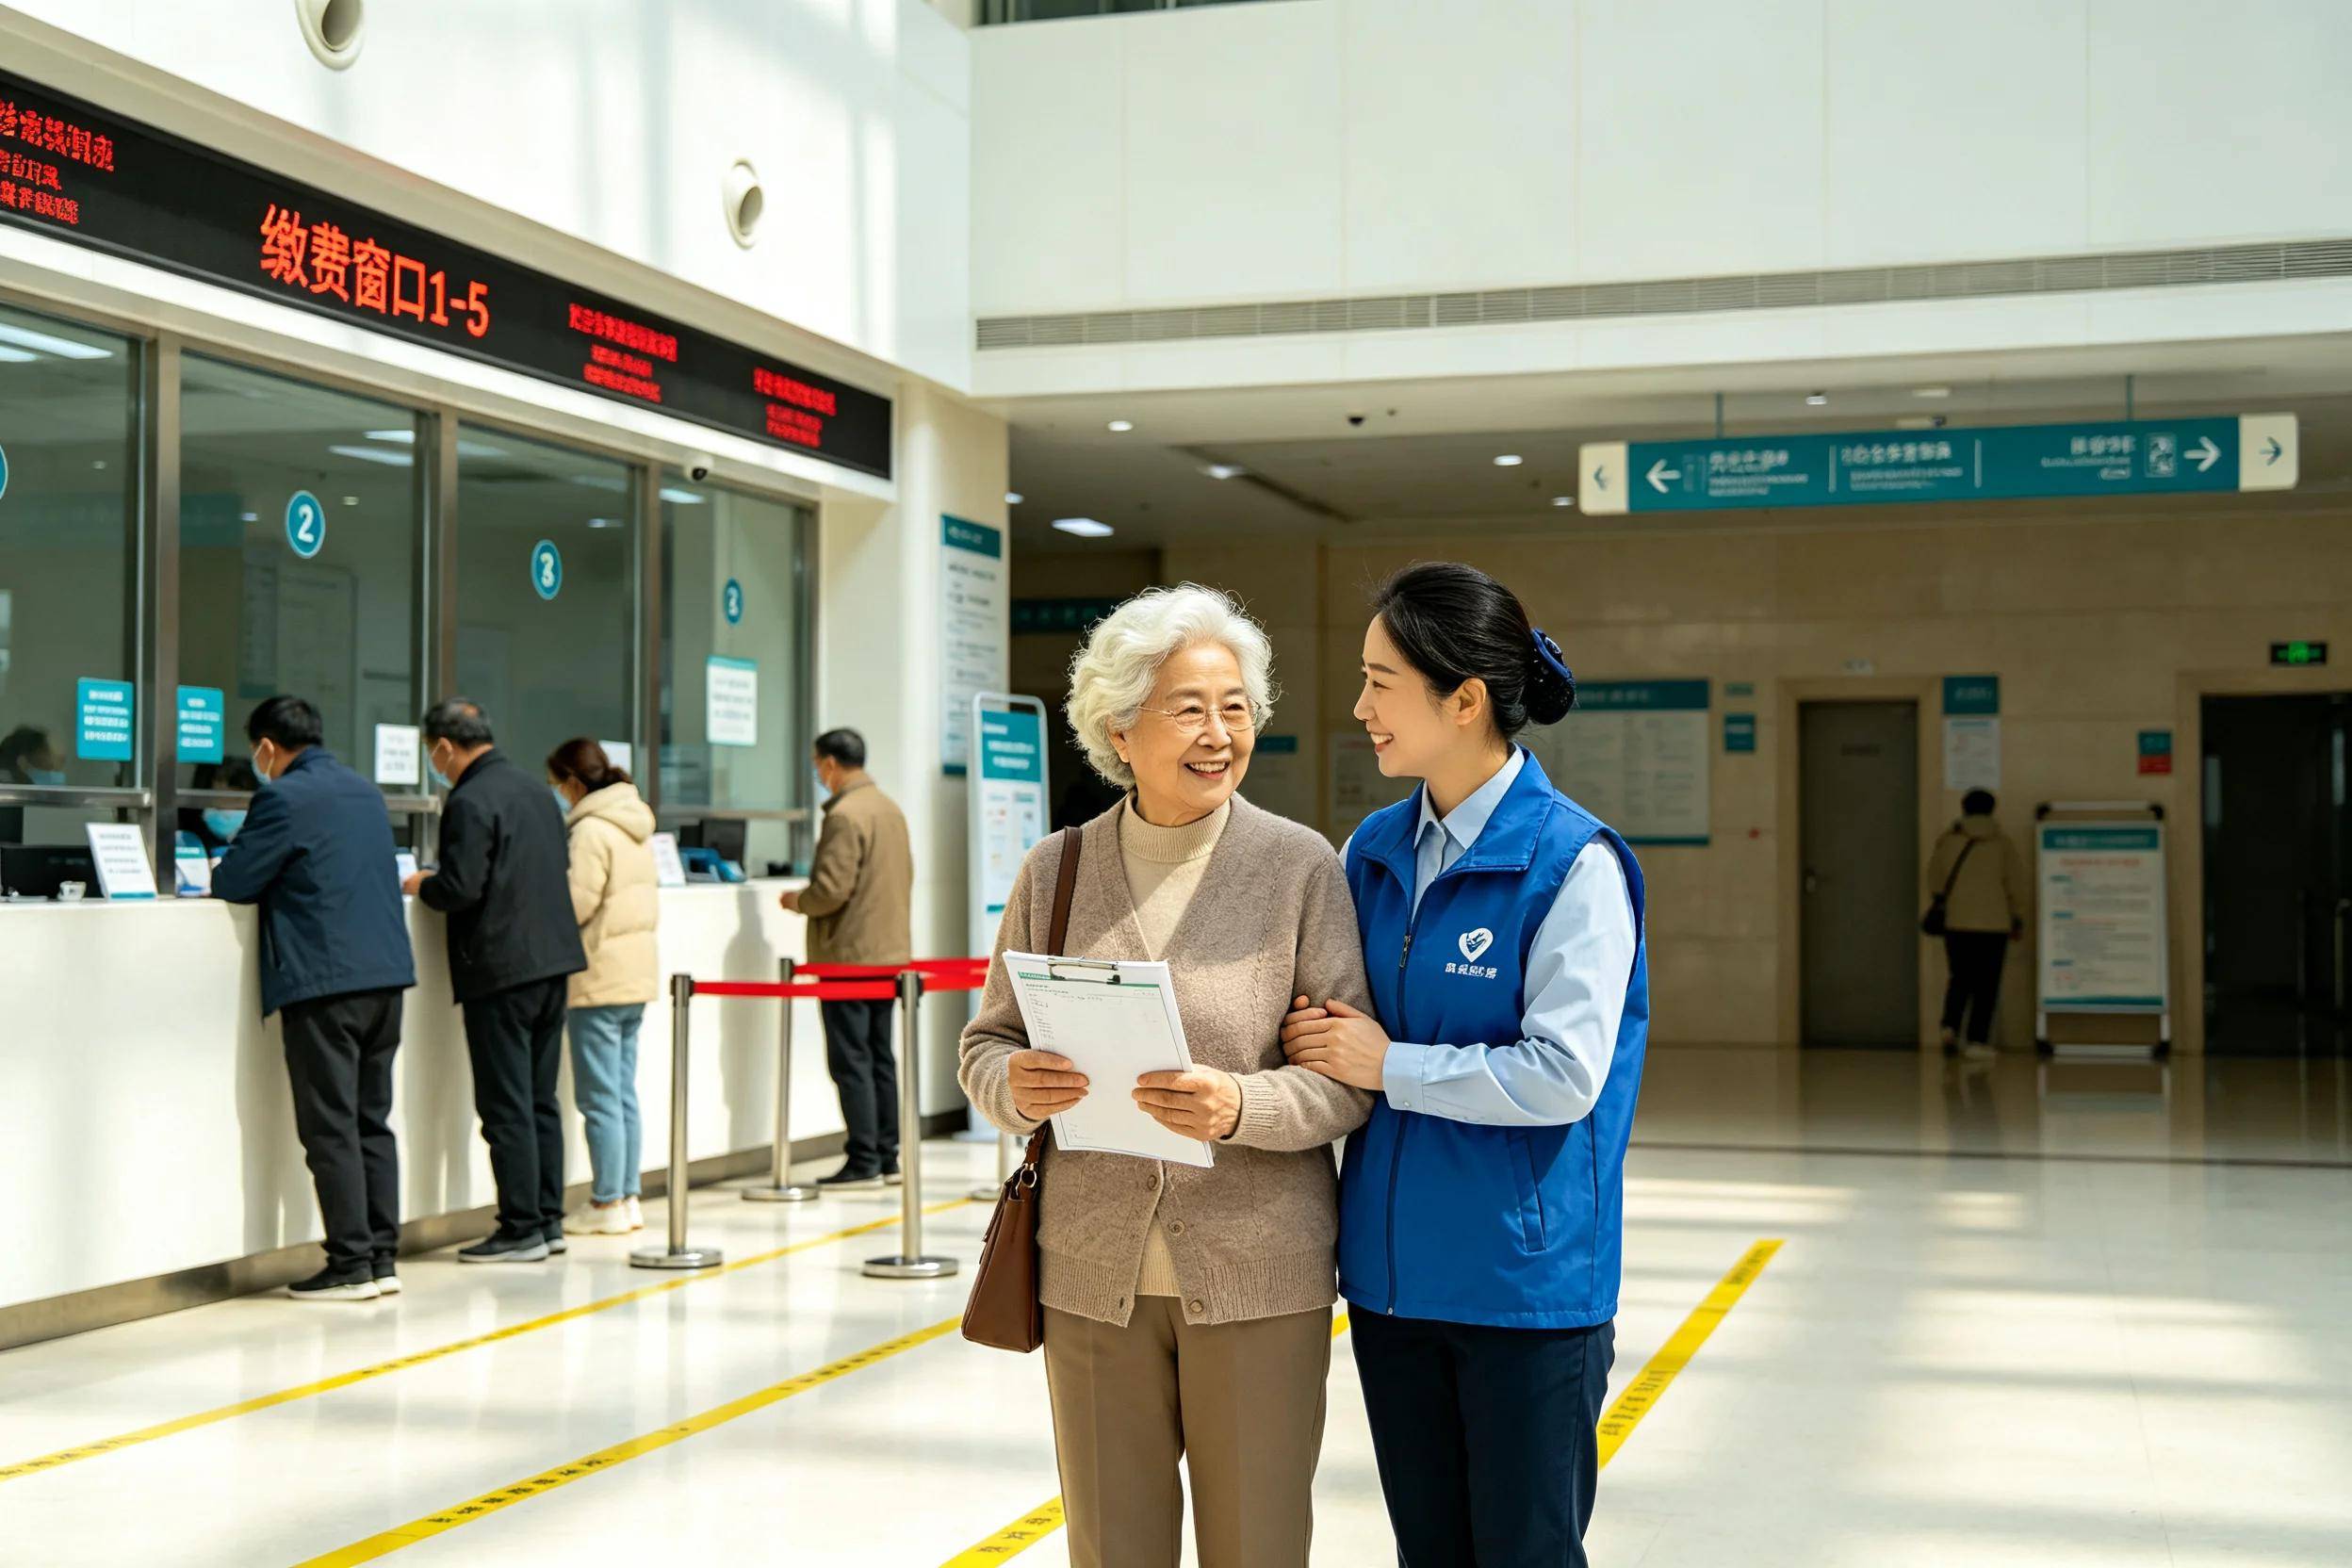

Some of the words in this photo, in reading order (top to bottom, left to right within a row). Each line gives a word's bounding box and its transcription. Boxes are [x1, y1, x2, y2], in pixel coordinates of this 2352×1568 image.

[260, 204, 489, 337] 缴费窗口1-5
[298, 503, 315, 544] 2
